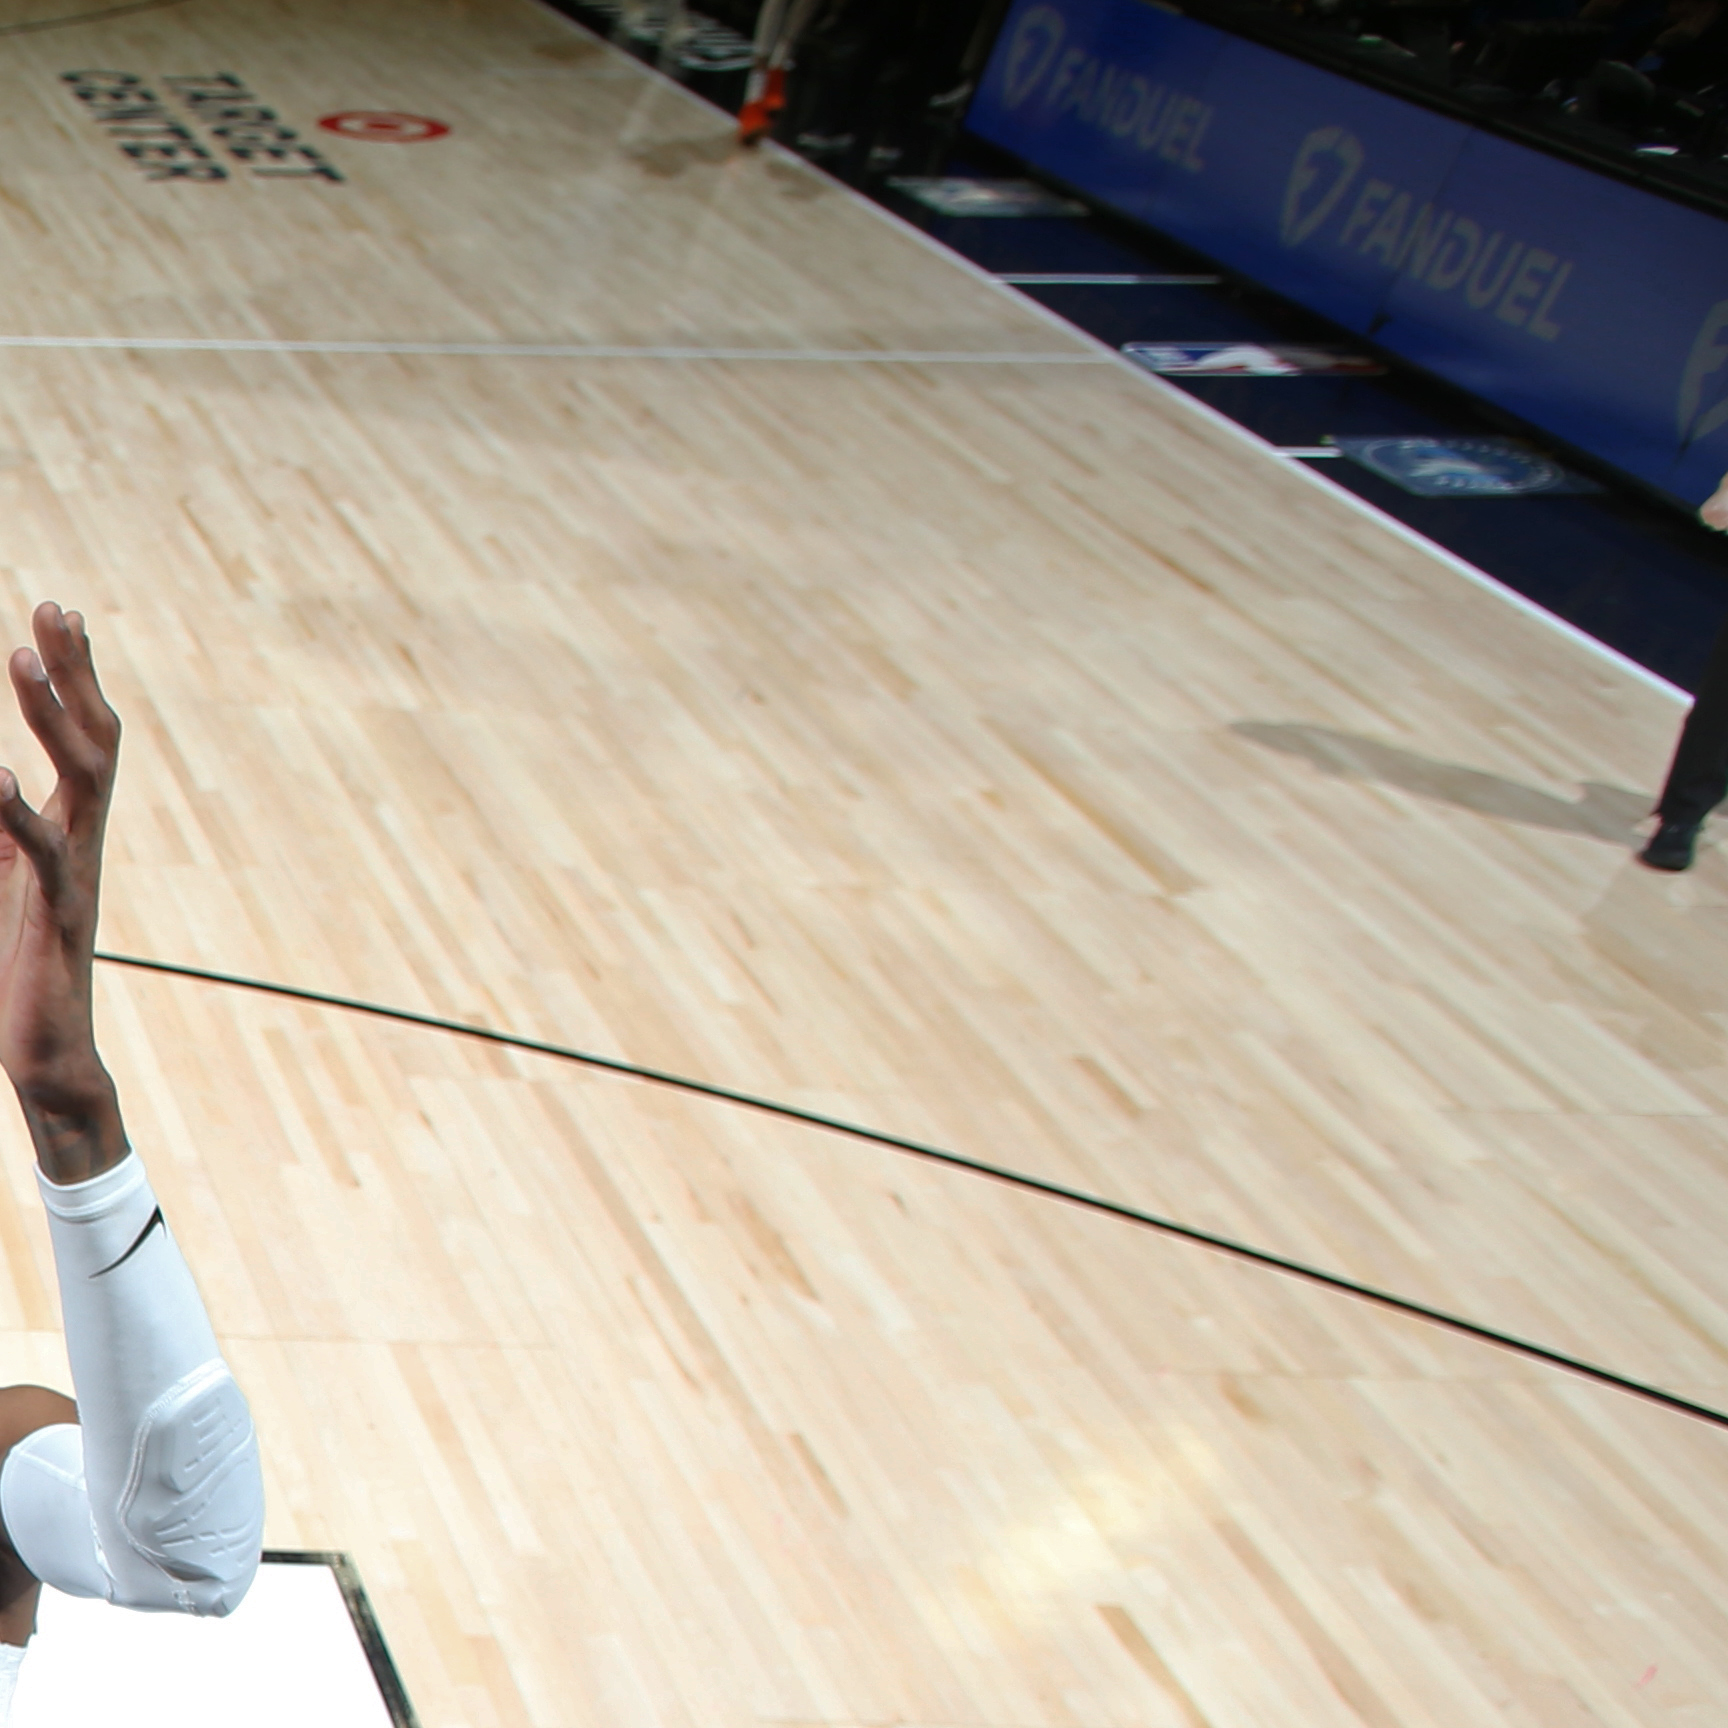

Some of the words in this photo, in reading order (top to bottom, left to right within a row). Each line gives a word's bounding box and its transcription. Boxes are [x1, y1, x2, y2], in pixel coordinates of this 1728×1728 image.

[58, 70, 228, 181] CENTER
[161, 71, 347, 183] TARGET
[1048, 48, 1215, 173] FANDUEL
[1339, 179, 1575, 340] FANDUEL
